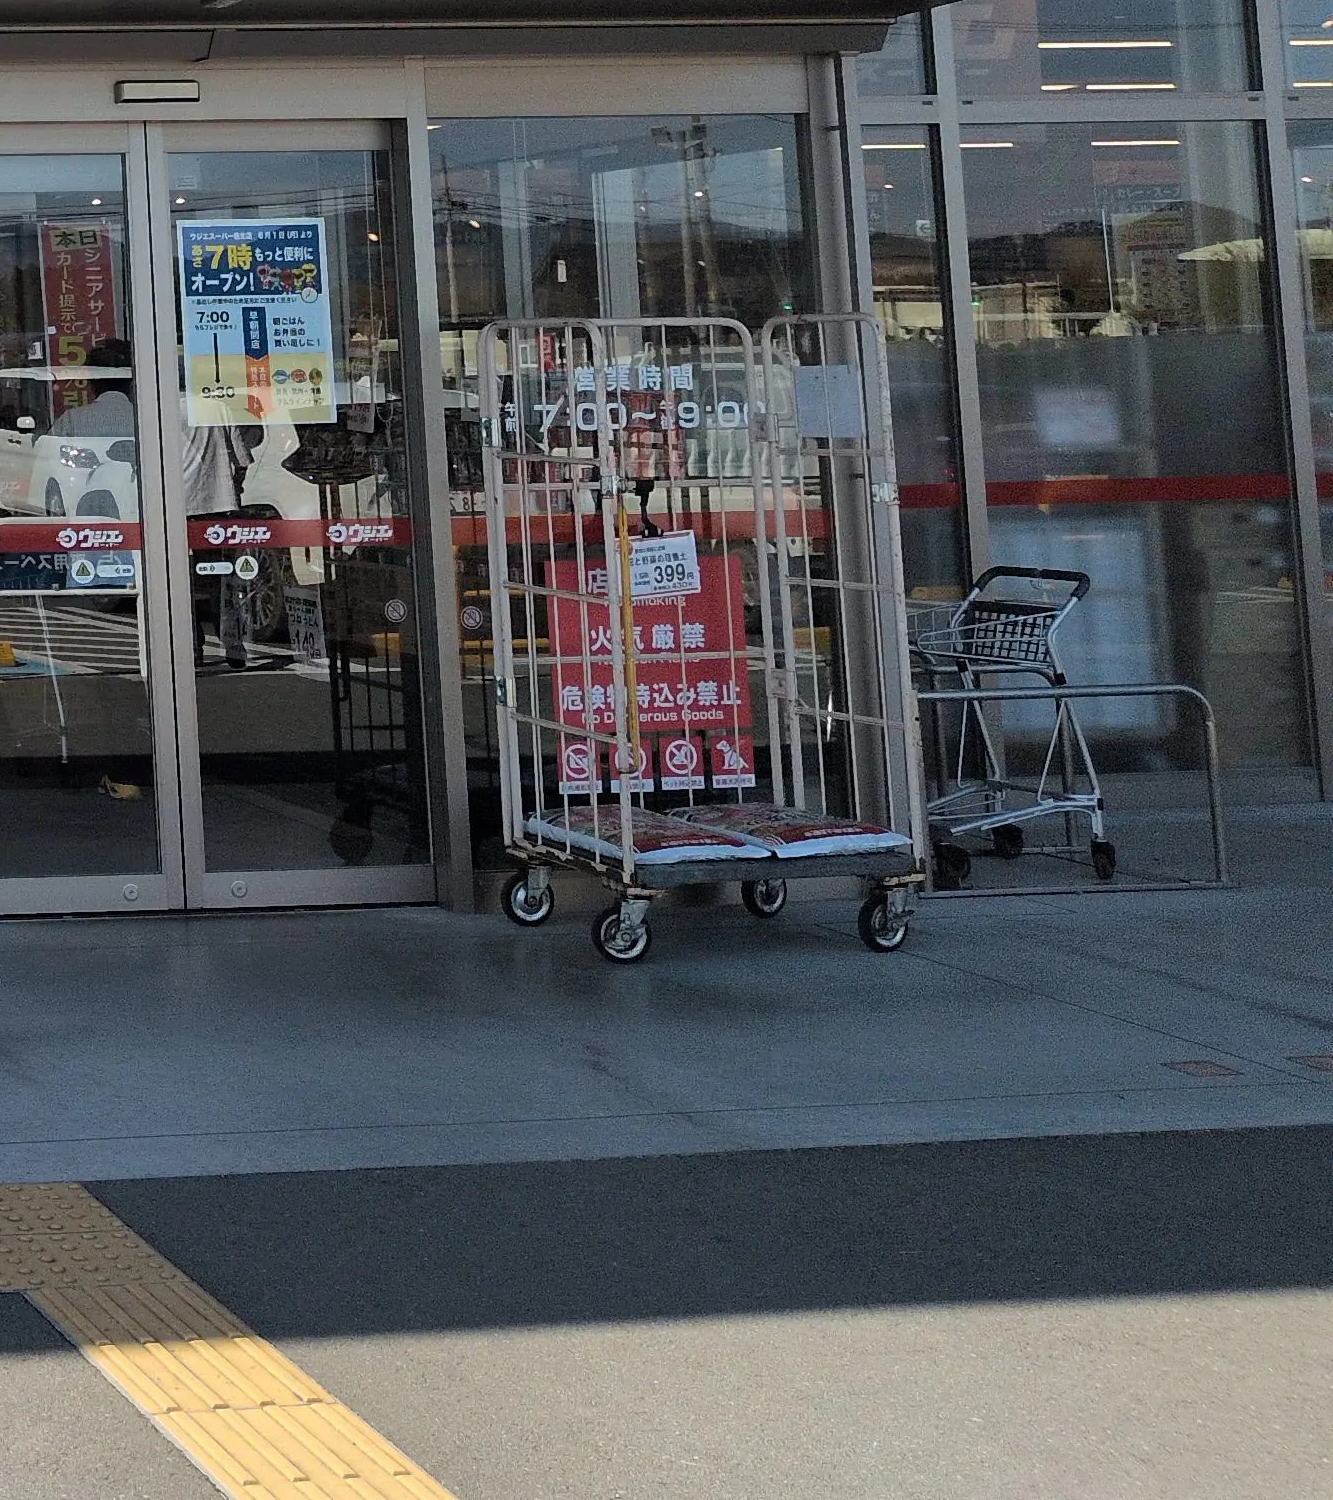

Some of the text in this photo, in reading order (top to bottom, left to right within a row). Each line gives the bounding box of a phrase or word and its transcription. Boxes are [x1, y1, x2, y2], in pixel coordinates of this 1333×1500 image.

[54, 230, 98, 248] 本日
[191, 244, 314, 270] あさ 7時 もっと便利に
[191, 272, 255, 293] オープン!
[56, 252, 77, 334] カード提示で
[196, 311, 230, 324] 7:00
[574, 364, 694, 392] 営業時間
[79, 528, 124, 548] ウジエ
[226, 525, 271, 545] ウジエ
[348, 523, 393, 543] ウジエ
[654, 563, 686, 584] 399
